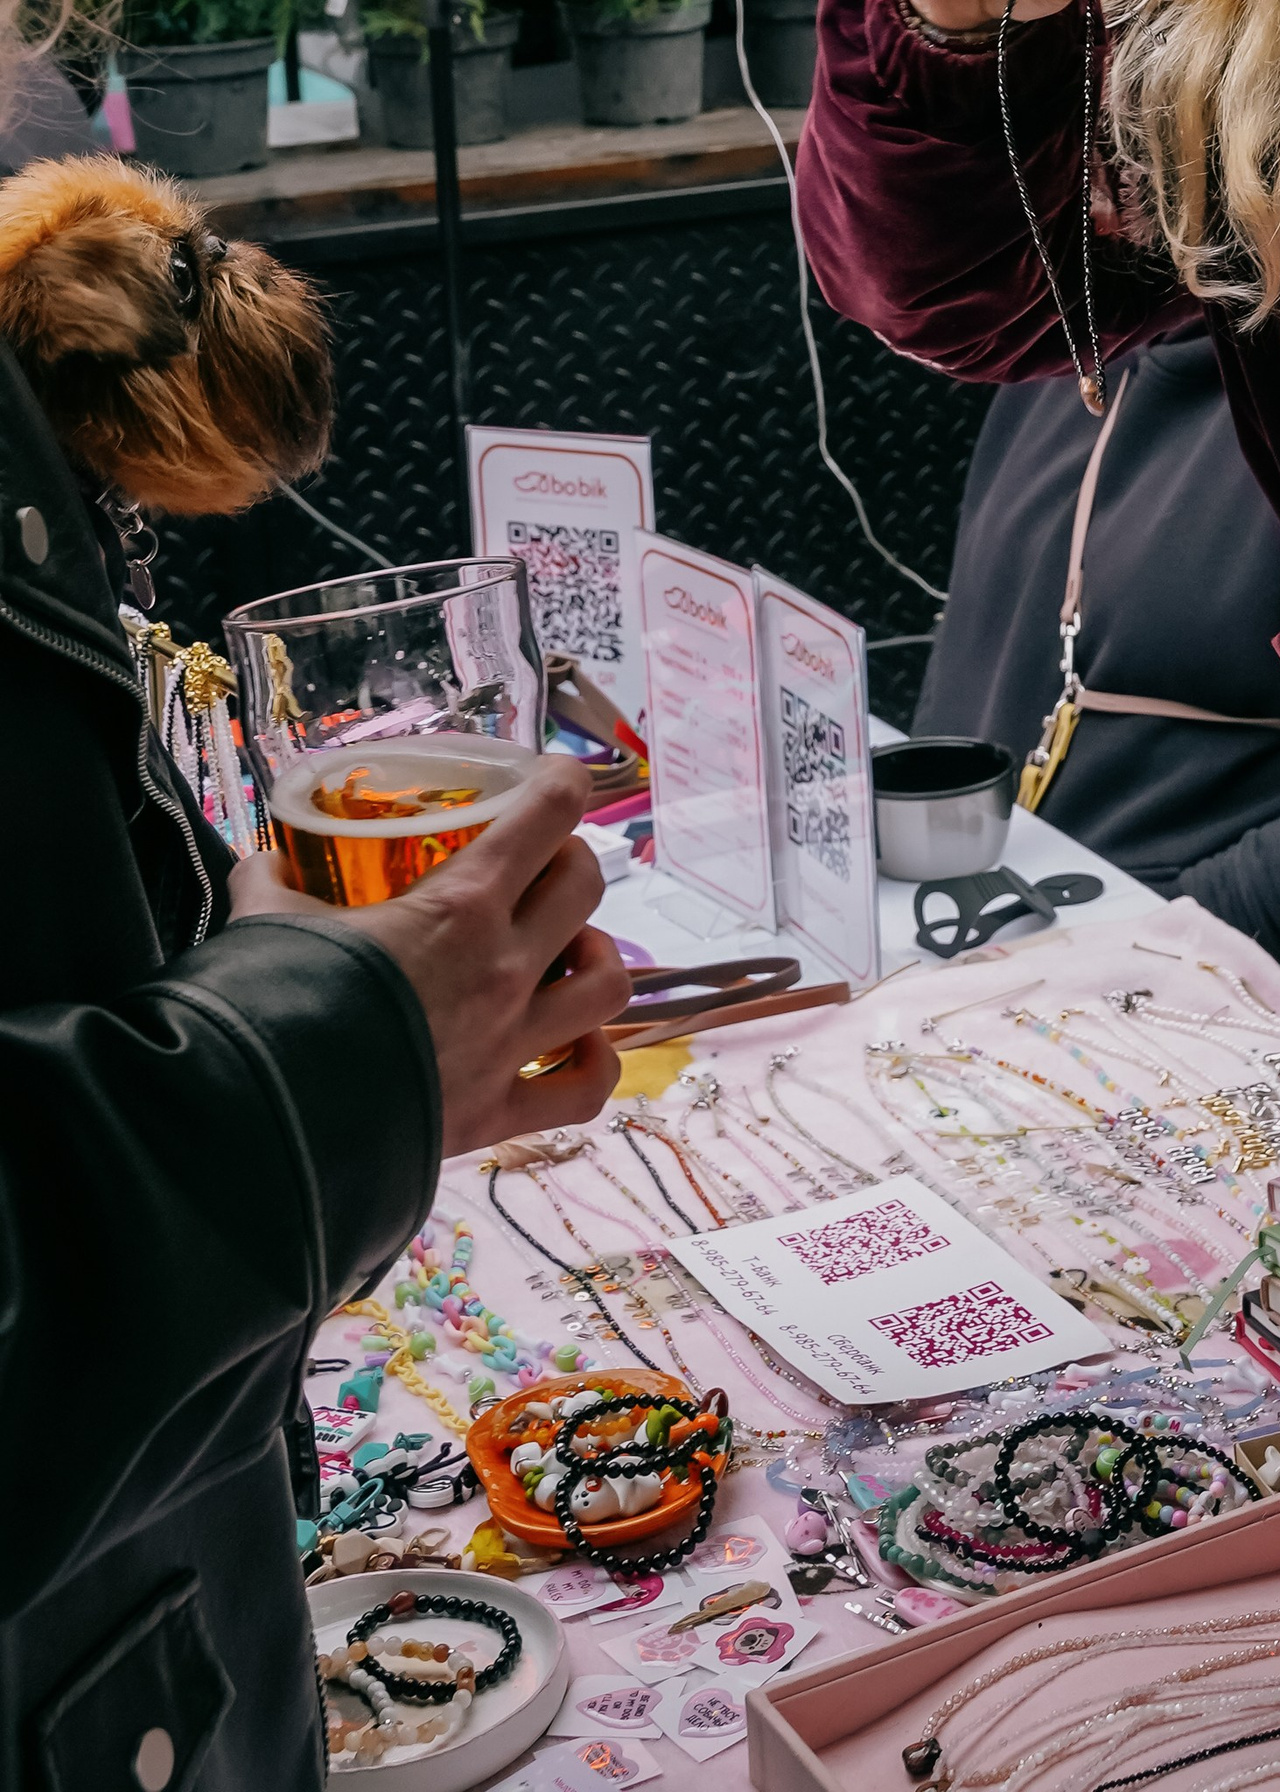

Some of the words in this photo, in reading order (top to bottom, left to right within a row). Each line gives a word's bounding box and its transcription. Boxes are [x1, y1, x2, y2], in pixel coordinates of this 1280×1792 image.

[550, 474, 608, 498] bobik
[691, 1240, 779, 1316] 8-985-279-67-64
[778, 1324, 877, 1396] 8-985-279-67-64
[827, 1334, 885, 1376] Сбербанк
